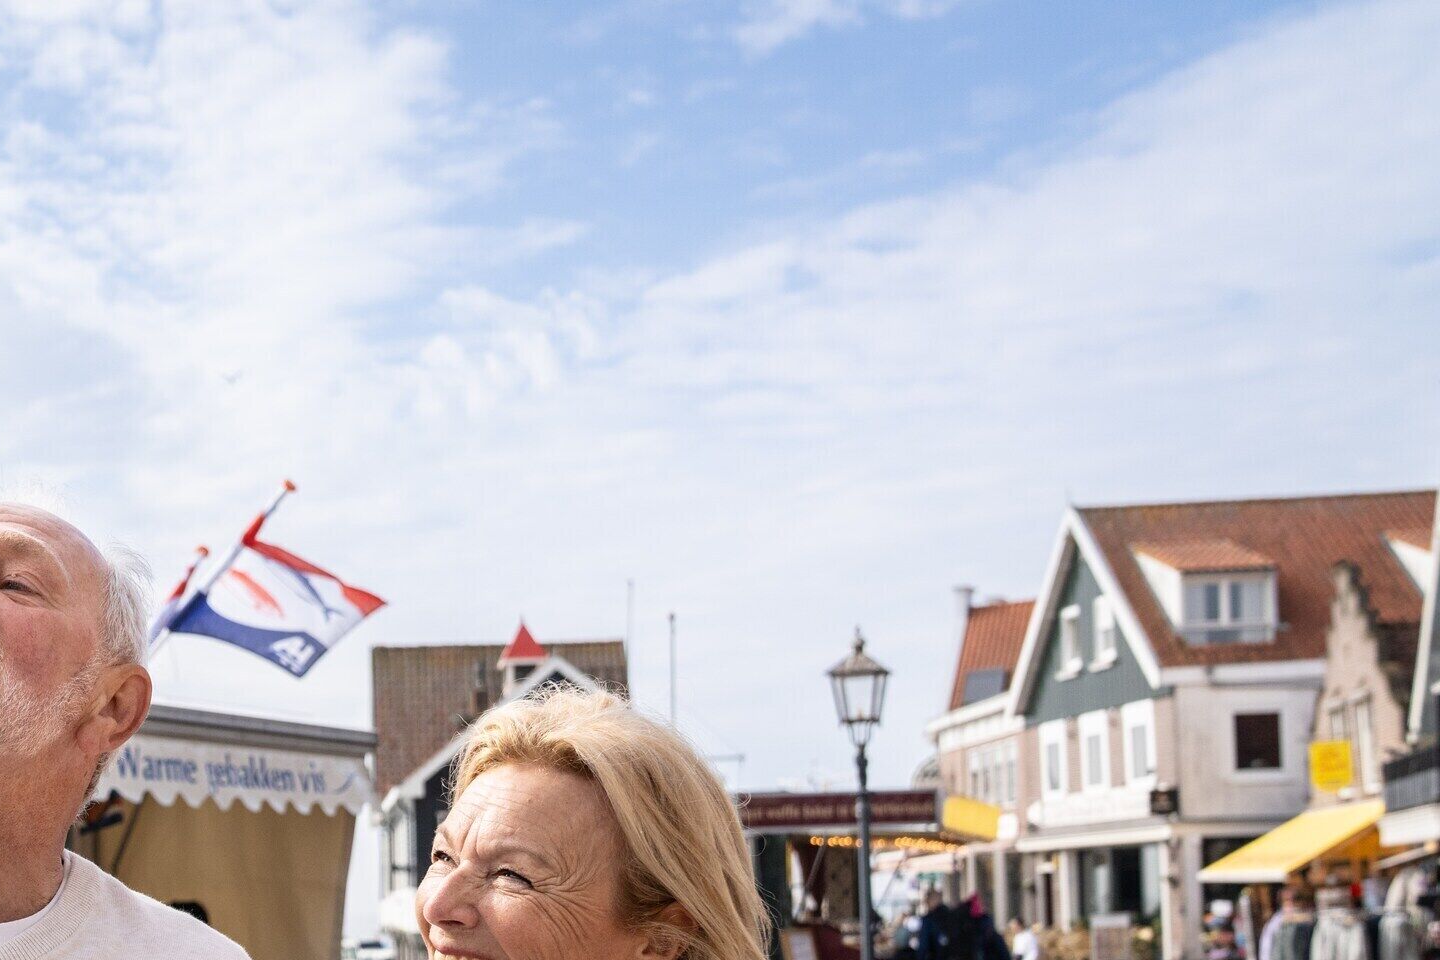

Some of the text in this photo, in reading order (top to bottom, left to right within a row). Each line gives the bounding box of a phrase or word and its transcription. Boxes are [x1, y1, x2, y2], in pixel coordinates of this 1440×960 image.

[117, 745, 326, 795] Warme gebakken vis
